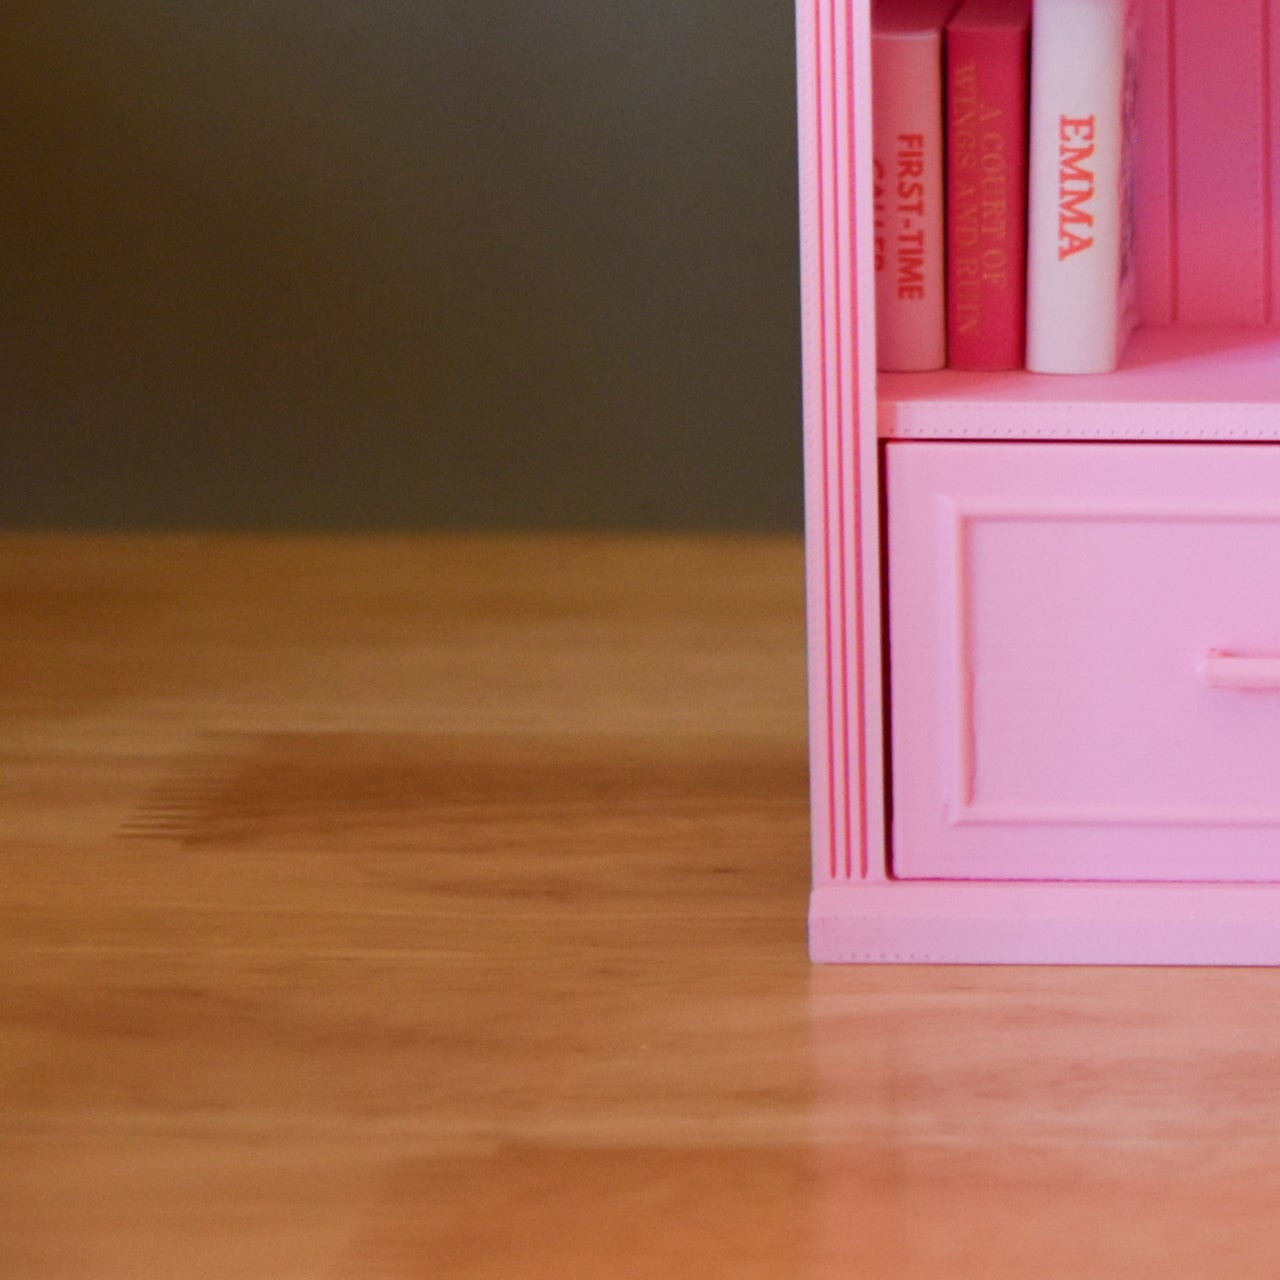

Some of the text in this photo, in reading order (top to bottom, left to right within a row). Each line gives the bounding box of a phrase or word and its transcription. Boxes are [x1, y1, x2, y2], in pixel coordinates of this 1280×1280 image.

[896, 132, 925, 302] FIRST-TIME
[953, 63, 981, 334] WINGS AND RUIN
[980, 104, 1008, 290] A COURT OF
[1058, 114, 1096, 262] EMMA
